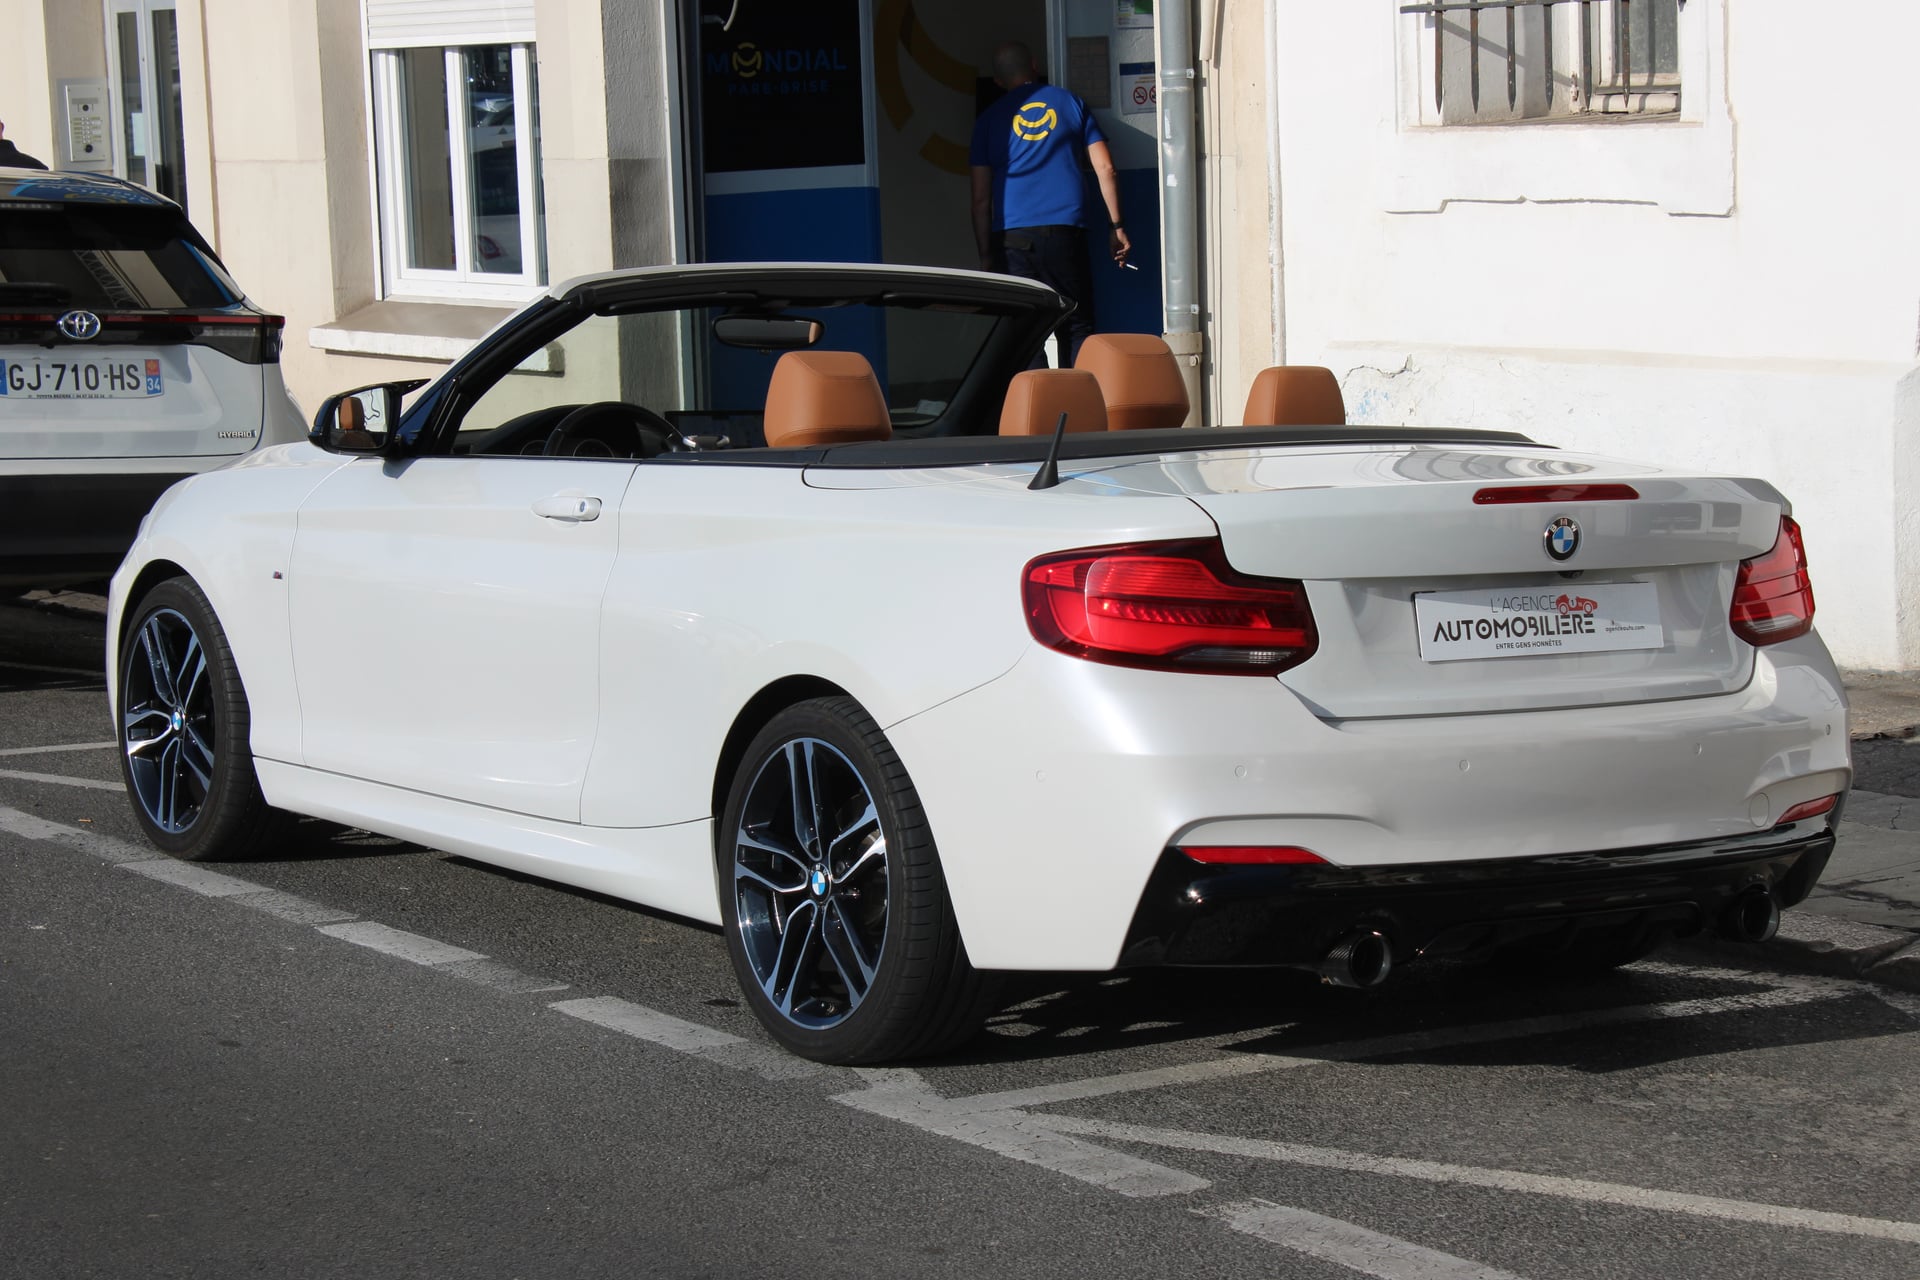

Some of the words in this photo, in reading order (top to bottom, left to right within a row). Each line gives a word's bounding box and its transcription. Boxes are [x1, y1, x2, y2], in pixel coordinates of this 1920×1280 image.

[9, 363, 141, 391] GJ-710-HS
[147, 377, 161, 391] 34
[218, 431, 252, 439] HYBRID
[1550, 518, 1578, 532] BMW
[1490, 595, 1557, 613] L'AGENCE
[1495, 642, 1514, 650] ENTRE
[1515, 641, 1531, 649] GENS
[1532, 639, 1562, 648] HONNÊTES
